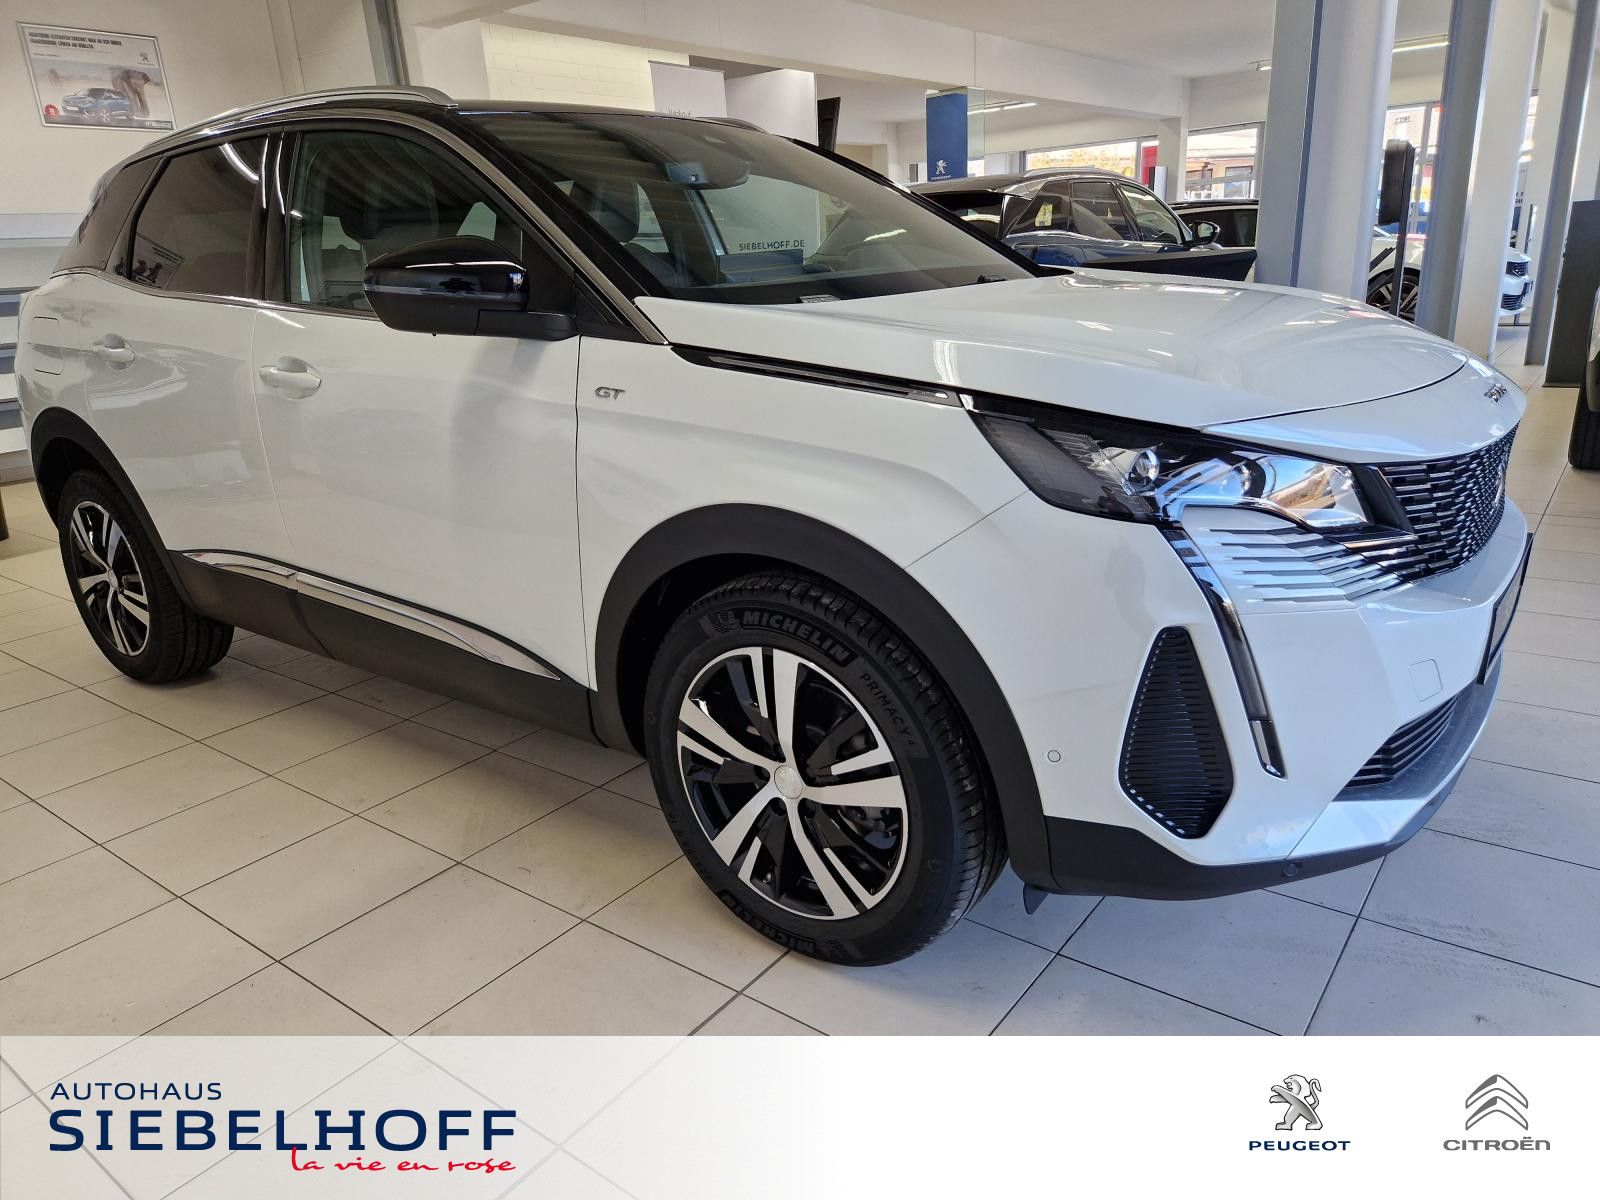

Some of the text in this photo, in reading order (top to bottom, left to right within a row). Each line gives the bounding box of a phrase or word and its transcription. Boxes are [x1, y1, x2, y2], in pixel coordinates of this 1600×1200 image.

[739, 240, 805, 251] SIEBELHOFF.DE
[594, 386, 626, 400] GT
[743, 610, 850, 661] MICHELIN
[859, 673, 911, 736] PRIMACY
